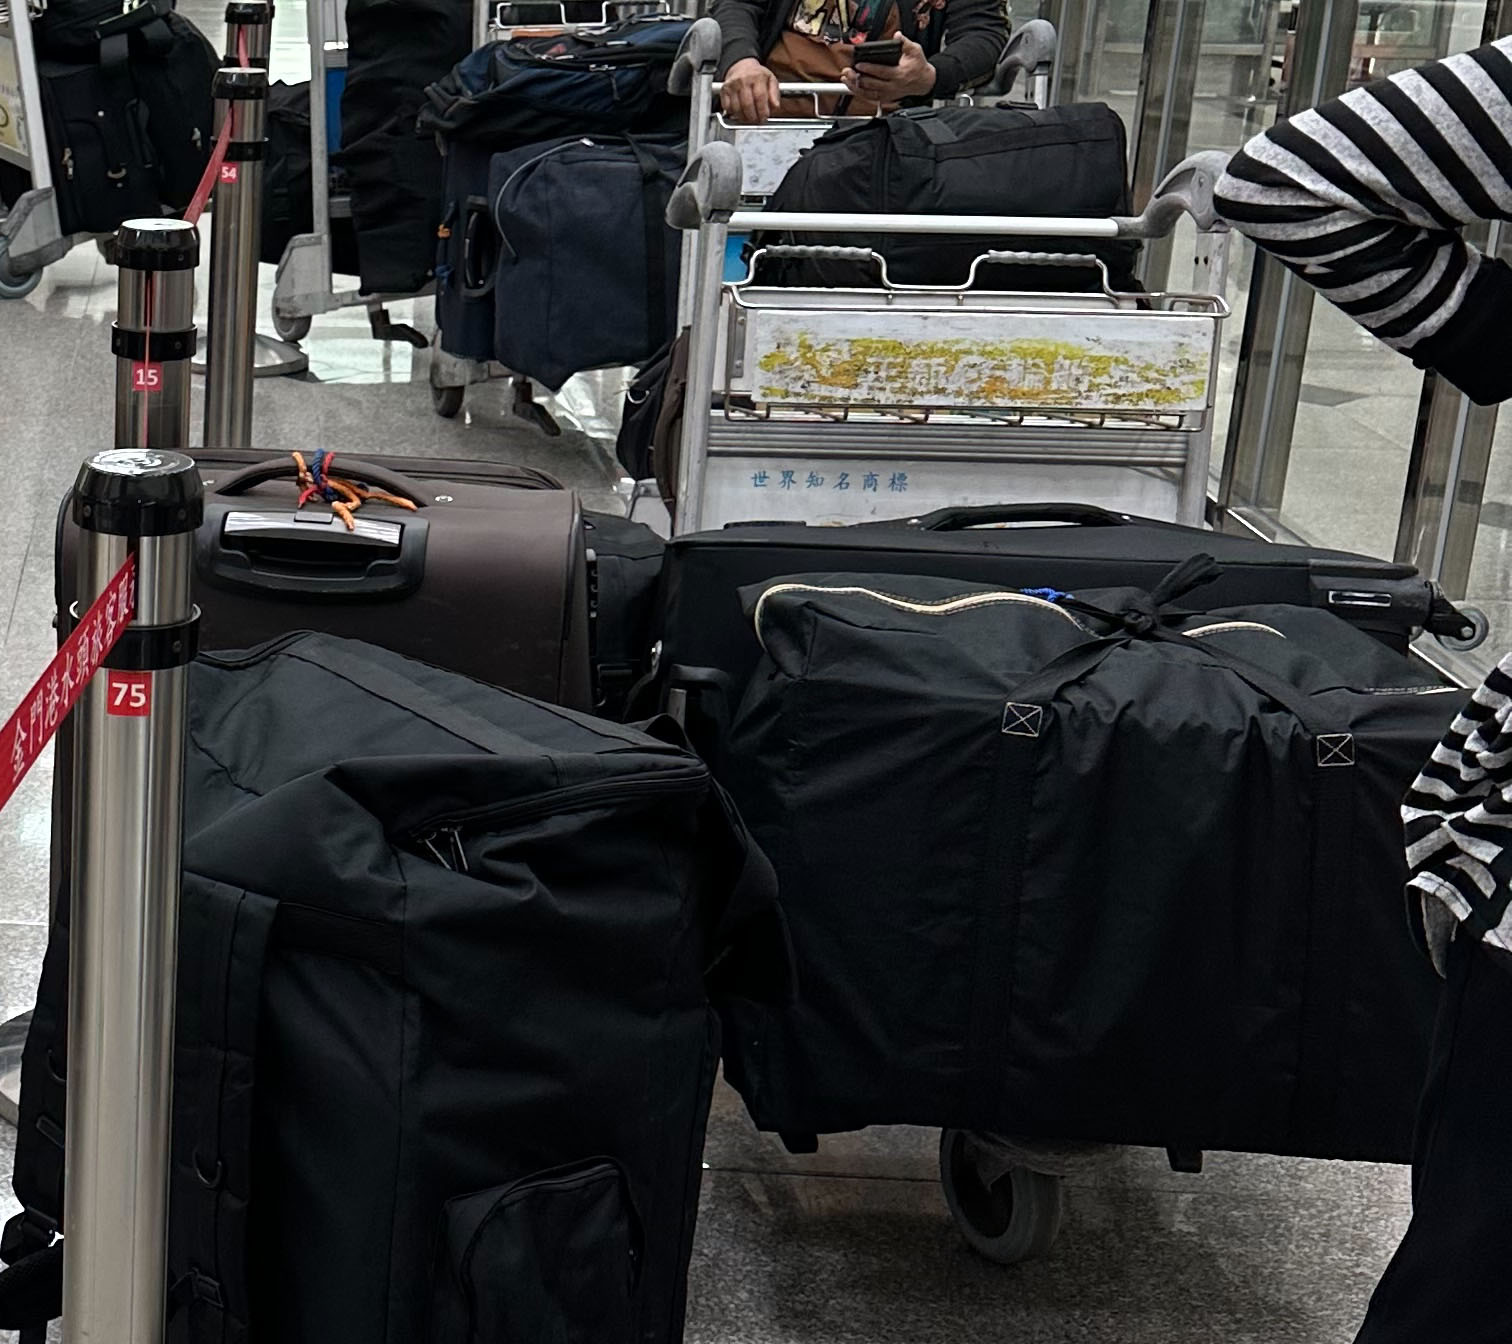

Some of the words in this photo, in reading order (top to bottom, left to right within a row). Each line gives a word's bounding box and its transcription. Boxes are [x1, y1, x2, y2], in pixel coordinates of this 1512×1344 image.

[222, 166, 237, 179] 54
[136, 369, 159, 386] 15
[751, 470, 909, 494] 世界知名商標
[112, 682, 147, 707] 75
